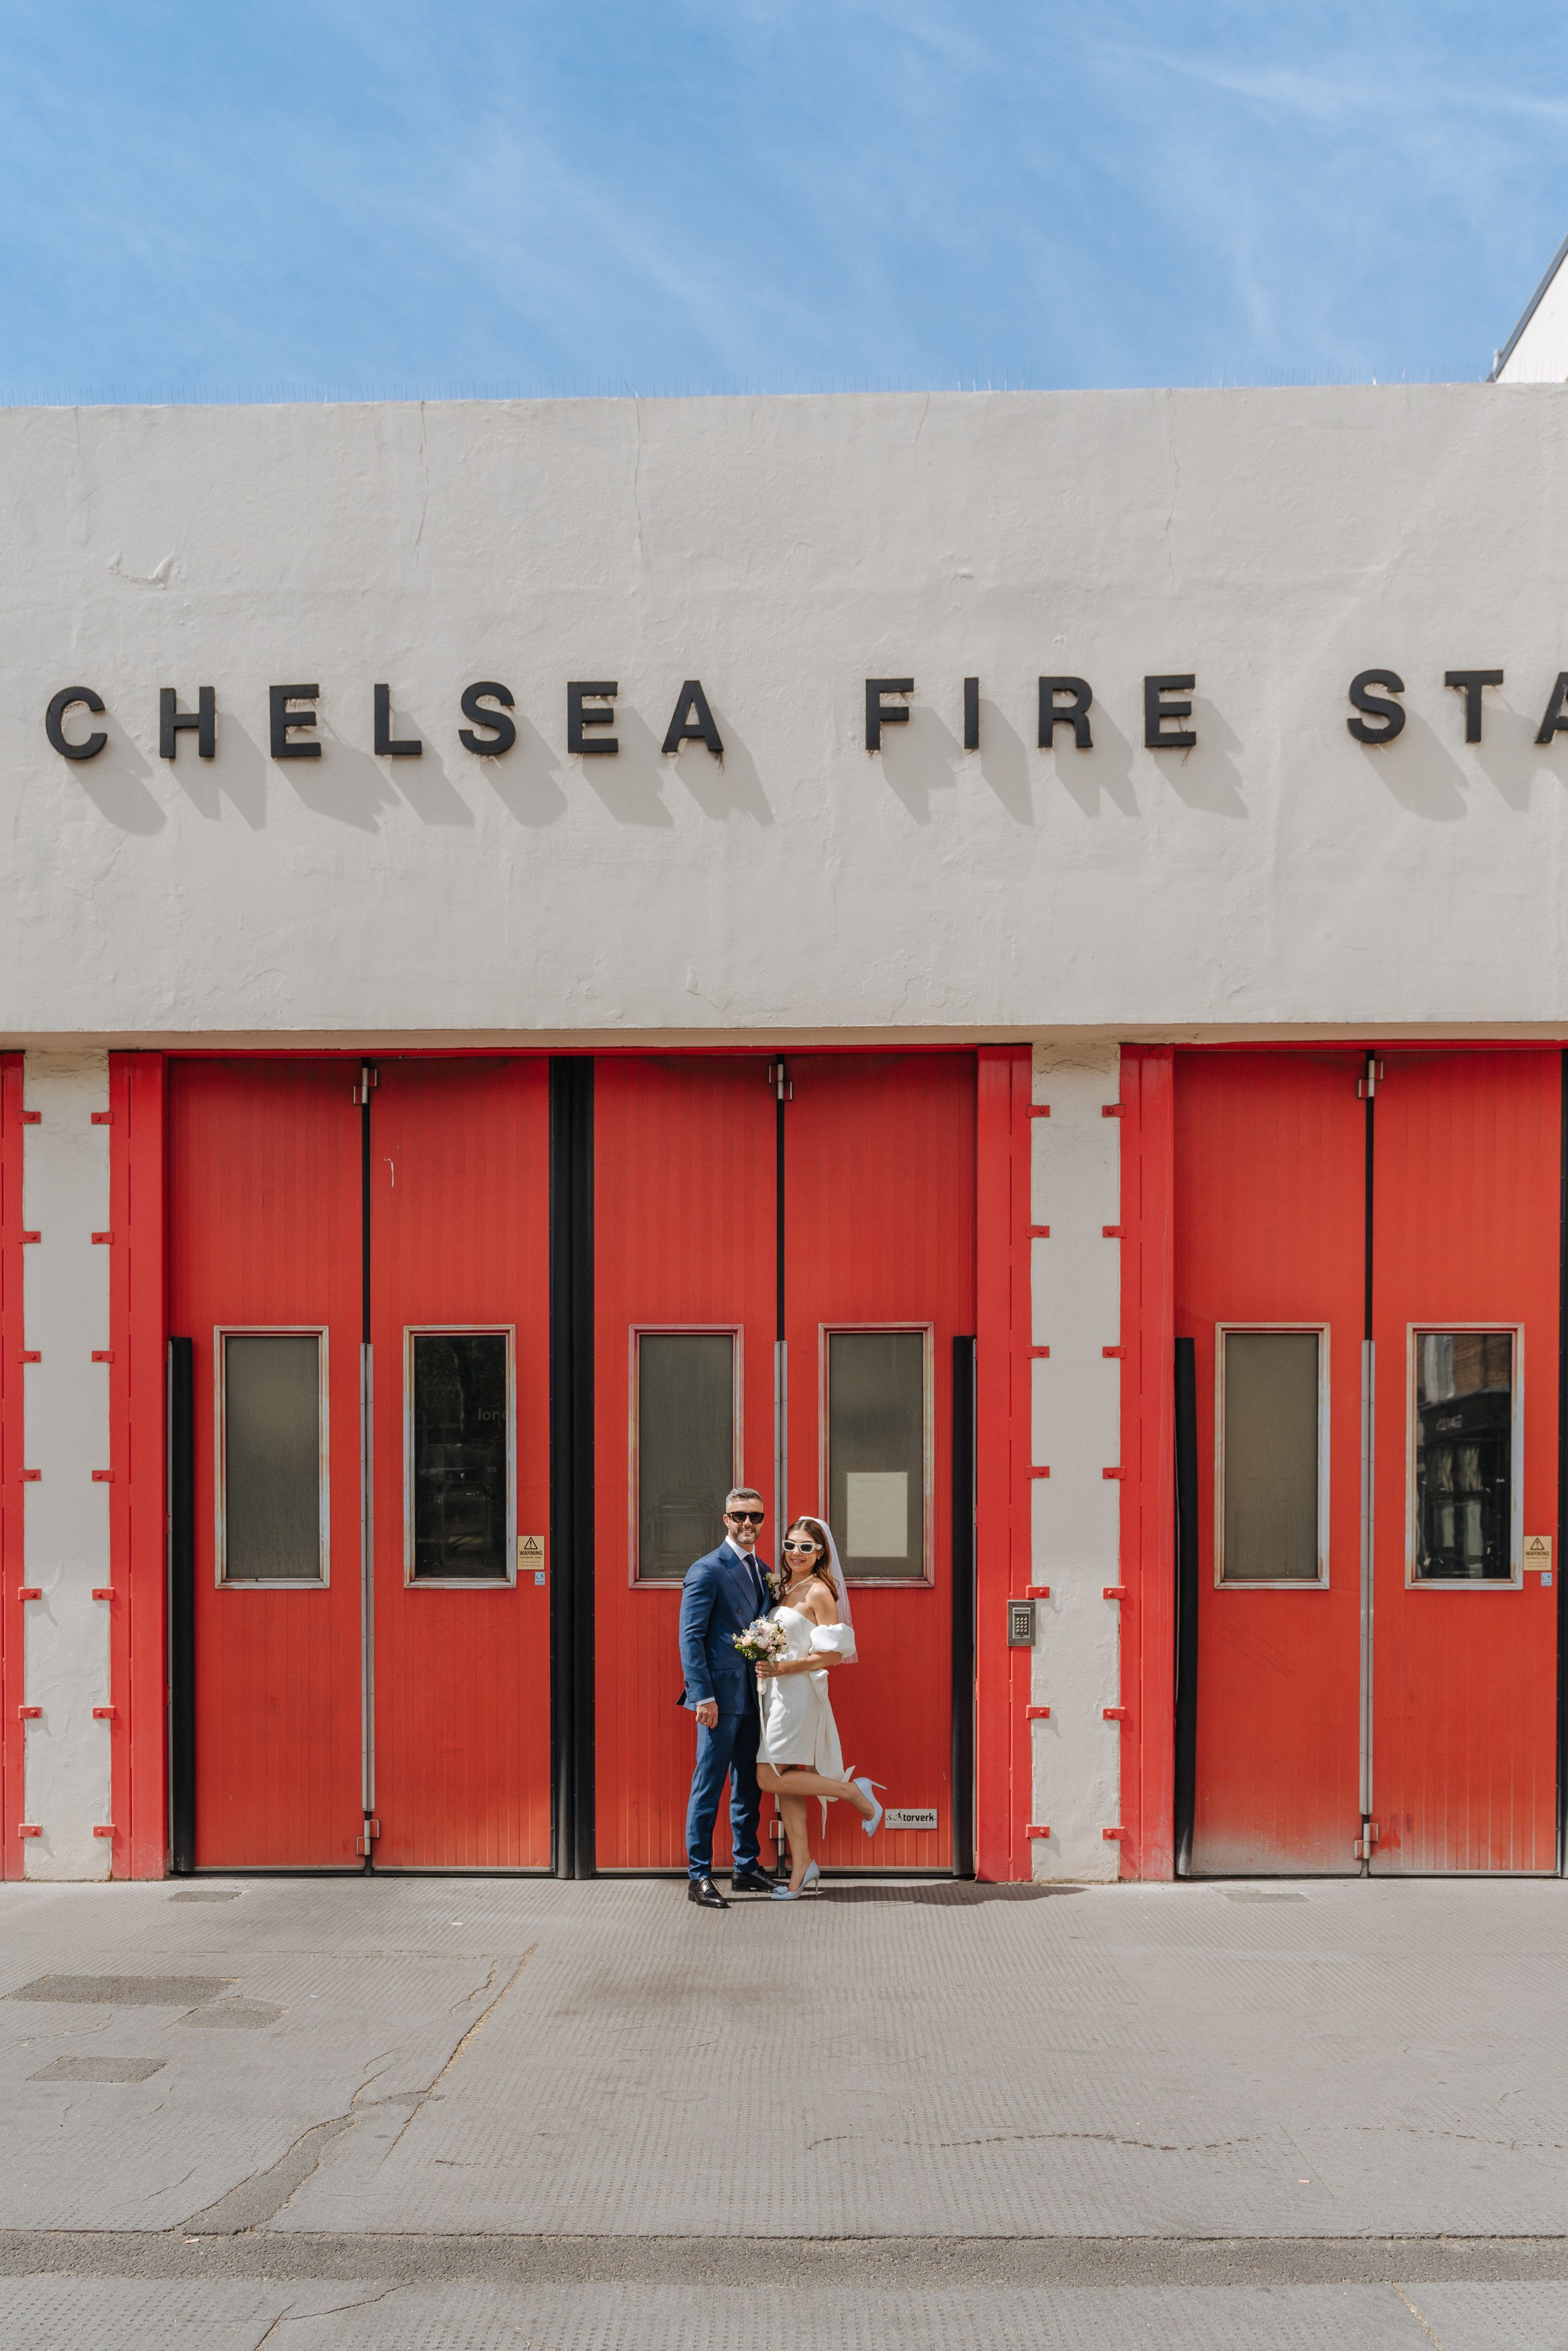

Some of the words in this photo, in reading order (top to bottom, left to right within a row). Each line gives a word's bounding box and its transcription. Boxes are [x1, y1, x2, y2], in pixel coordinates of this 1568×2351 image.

[46, 680, 724, 760] CHELSEA
[865, 674, 1197, 752] FIRE
[1346, 669, 1568, 746] STA
[903, 1812, 934, 1822] torverk
